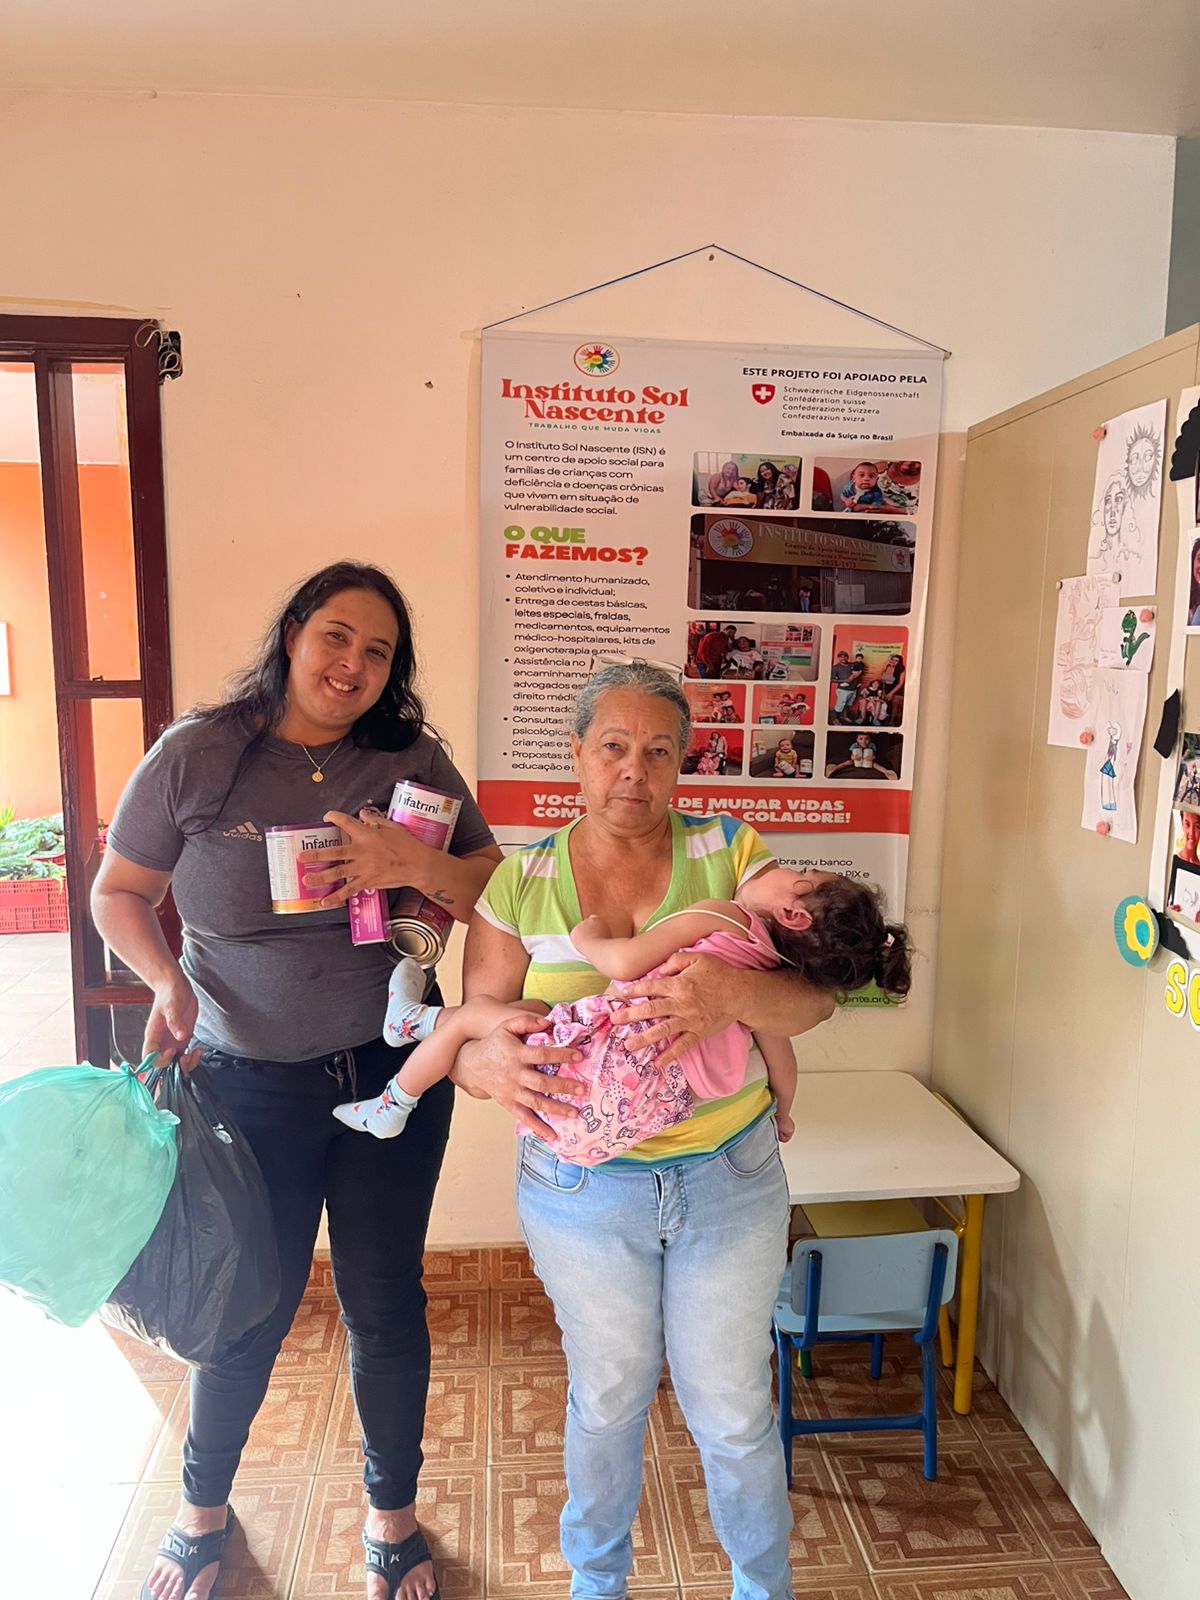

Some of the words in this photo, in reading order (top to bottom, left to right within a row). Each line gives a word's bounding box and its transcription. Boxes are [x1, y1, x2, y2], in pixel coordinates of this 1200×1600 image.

[743, 368, 768, 376] ESTE
[771, 370, 819, 380] PROJETO
[844, 373, 896, 383] APOIADO
[900, 375, 928, 383] PELA
[501, 378, 635, 404] Instituto
[642, 386, 688, 406] Sol
[784, 386, 843, 395] Schweizerische
[846, 389, 919, 398] Eidgenossenschaft
[783, 395, 840, 404] Confédération
[524, 400, 665, 424] Nascente
[783, 404, 845, 413] Confederazione
[782, 413, 840, 421] Confederaziun
[781, 430, 823, 438] Embaixada
[516, 441, 560, 450] Instituto
[562, 443, 578, 451] Sol
[580, 444, 630, 454] Nascente
[633, 446, 657, 455] (ISN)
[524, 454, 560, 463] centro
[562, 455, 575, 464] de
[577, 457, 607, 466] apoio
[609, 458, 638, 467] social
[640, 460, 664, 468] para
[547, 467, 560, 476] de
[563, 468, 607, 479] crianças
[505, 478, 561, 489] deficiência
[572, 482, 618, 492] doenças
[619, 482, 664, 492] crônicas
[504, 492, 524, 502] que
[527, 492, 558, 500] vivem
[560, 494, 577, 502] em
[579, 493, 623, 504] situação
[626, 495, 639, 503] de
[504, 503, 583, 513] vulnerabilidade
[585, 506, 617, 514] social.
[504, 525, 525, 541] O
[530, 526, 585, 543] QUE
[506, 544, 648, 566] FAZEMOS?
[515, 573, 582, 582] Atendimento
[584, 575, 650, 586] humanizado,
[515, 585, 556, 594] coletivo
[565, 587, 615, 596] individual;
[515, 597, 554, 607] Entrega
[557, 598, 570, 606] de
[572, 599, 605, 607] cestas
[606, 600, 647, 609] básicas,
[515, 609, 542, 618] leites
[543, 610, 593, 620] especiais,
[594, 612, 631, 621] fraldas,
[515, 622, 594, 632] medicamentos,
[596, 625, 670, 634] equipamentos
[514, 634, 622, 645] médico-hospitalares,
[623, 636, 640, 644] kits
[642, 637, 656, 645] de
[514, 645, 589, 655] oxigenoterapia
[514, 657, 570, 666] Assistência
[573, 659, 585, 667] no
[513, 681, 570, 690] advogados
[513, 692, 545, 700] direito
[513, 716, 563, 724] Consultas
[512, 728, 570, 736] psicológica
[512, 739, 555, 748] crianças
[512, 751, 562, 760] Propostas
[512, 762, 562, 771] educação
[399, 794, 440, 814] Infatrini
[533, 792, 585, 806] VOCÊ
[678, 798, 703, 808] DE
[708, 798, 781, 809] MUDAR
[533, 807, 580, 818] COM
[743, 811, 851, 824] COLABORE!
[820, 858, 852, 866] banco
[846, 870, 861, 878] PIX
